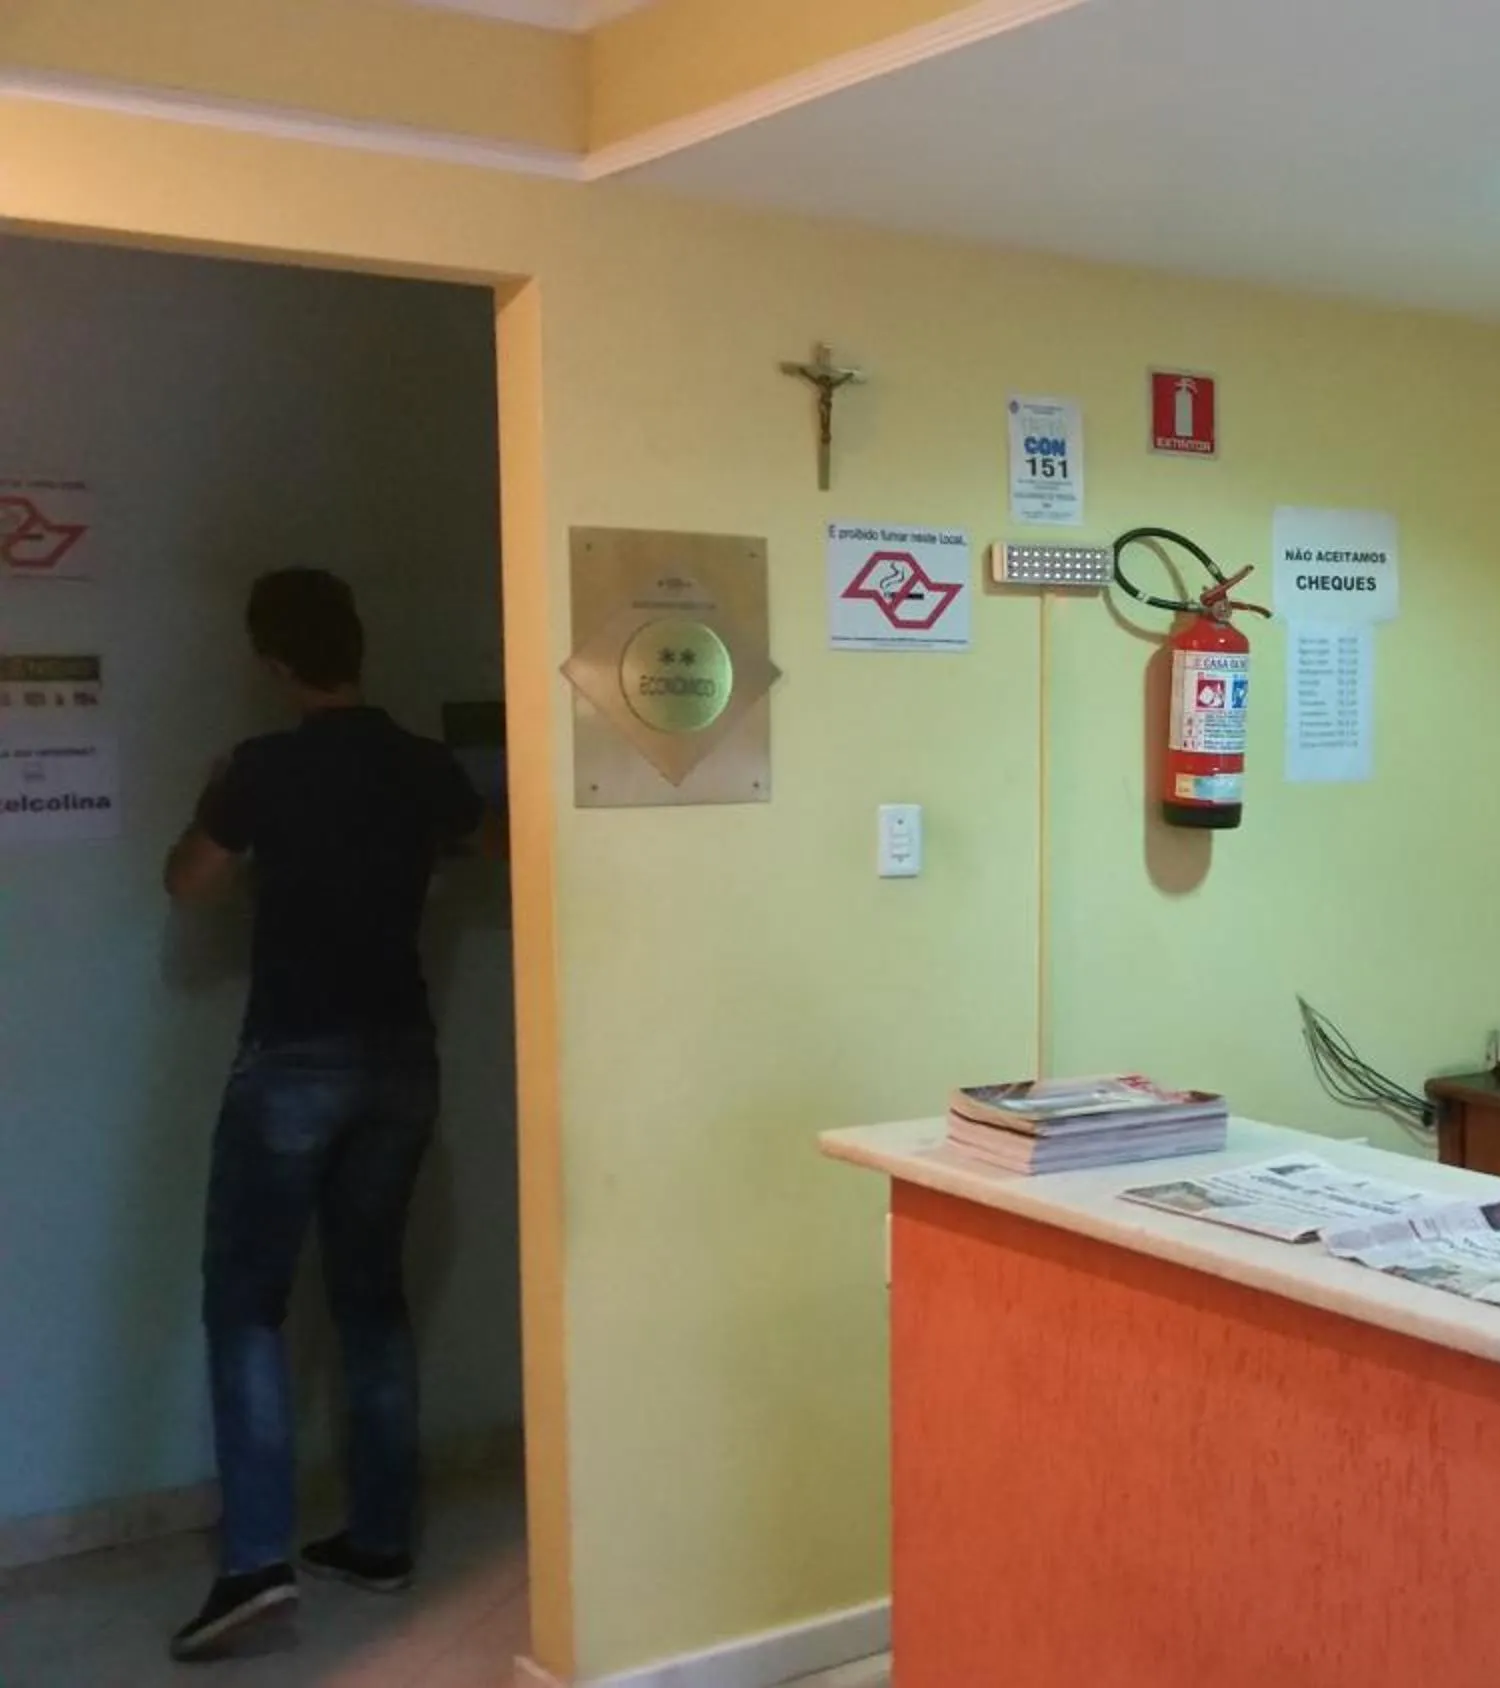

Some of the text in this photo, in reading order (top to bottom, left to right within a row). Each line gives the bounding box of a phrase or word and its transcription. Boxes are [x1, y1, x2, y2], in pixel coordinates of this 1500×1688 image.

[1024, 436, 1066, 456] CON
[1156, 437, 1210, 451] EXTINTOR
[1025, 457, 1068, 478] 151
[838, 527, 878, 541] proibido
[1316, 550, 1386, 563] ACEITAMOS
[1296, 575, 1377, 591] CHEQUES
